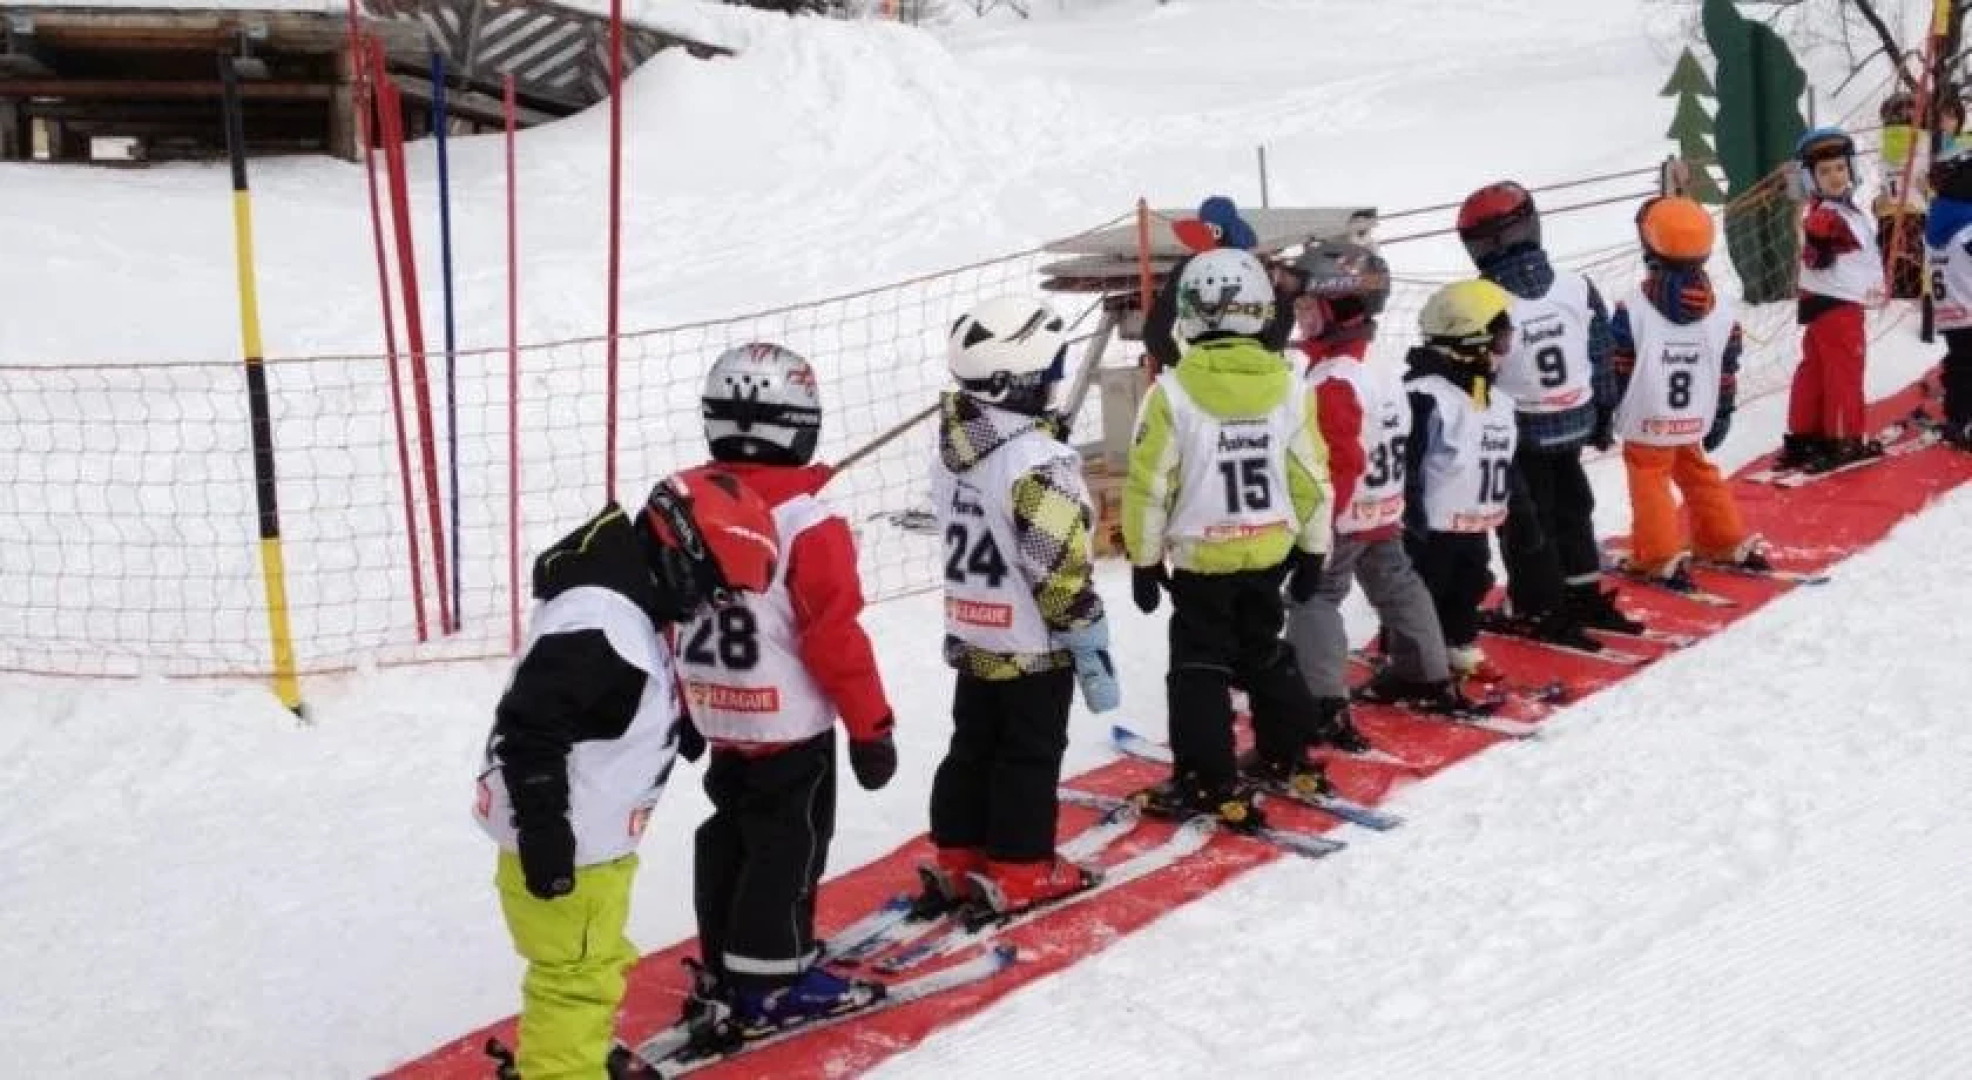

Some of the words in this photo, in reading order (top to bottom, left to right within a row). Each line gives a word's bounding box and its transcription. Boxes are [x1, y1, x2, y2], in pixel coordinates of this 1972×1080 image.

[1537, 346, 1566, 388] 9
[1668, 371, 1691, 409] 8
[1219, 458, 1270, 513] 15
[1364, 436, 1408, 487] 38
[1478, 457, 1508, 504] 10
[946, 523, 1008, 588] 24
[684, 604, 760, 671] 28
[711, 688, 775, 709] LEAGUE
